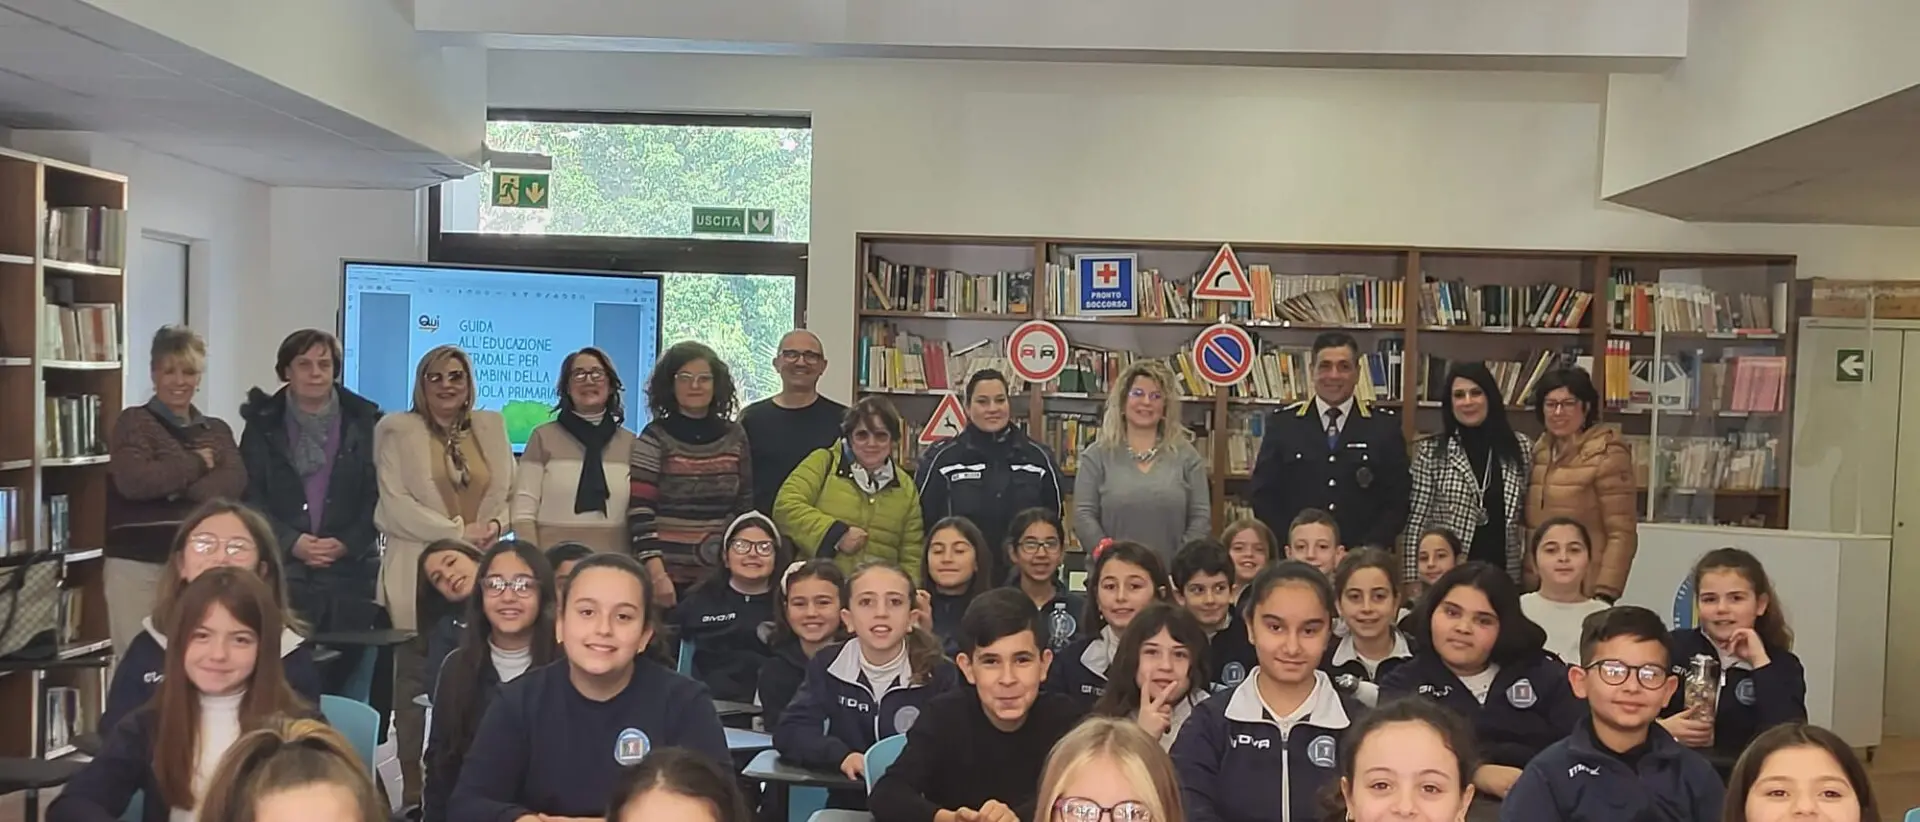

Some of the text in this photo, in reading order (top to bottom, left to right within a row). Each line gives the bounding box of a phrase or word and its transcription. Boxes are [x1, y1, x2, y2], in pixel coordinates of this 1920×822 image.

[696, 215, 741, 227] USCITA
[1091, 291, 1122, 299] PRONTO
[1086, 300, 1127, 308] SOCCORSO
[459, 319, 493, 332] GUIDA
[458, 335, 552, 351] ALL'EDUCAZIONE
[518, 353, 539, 366] PER
[514, 370, 550, 383] DELLA
